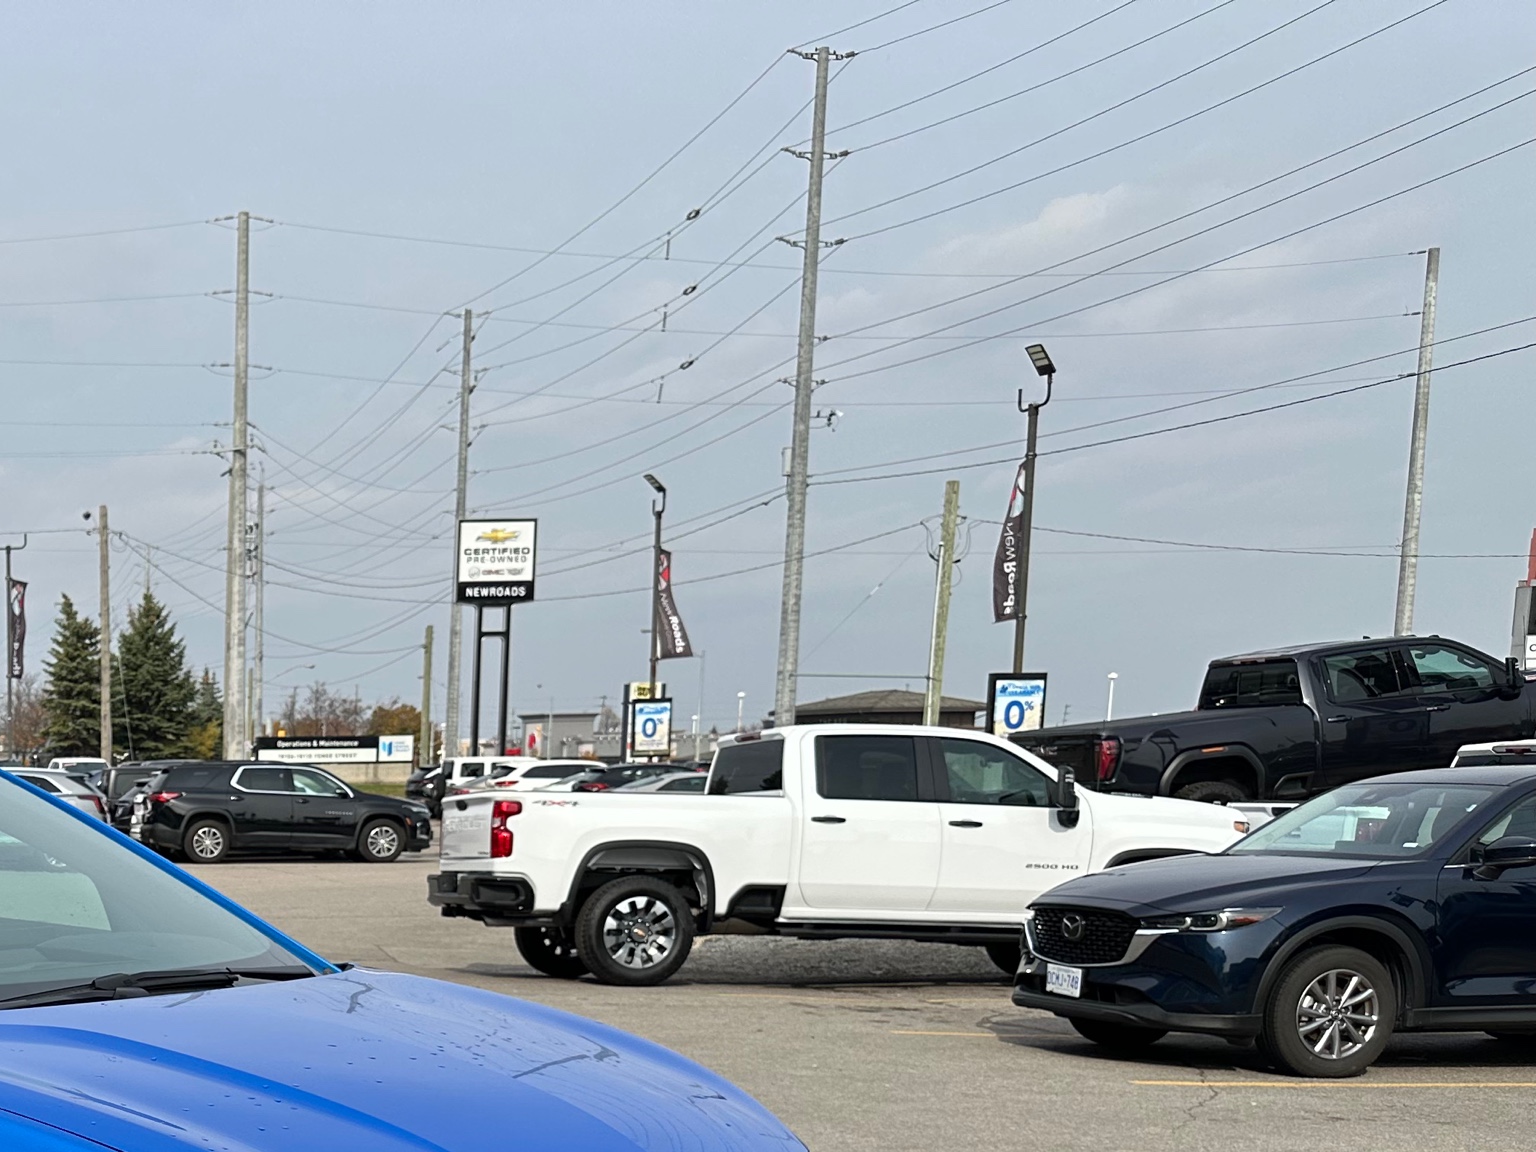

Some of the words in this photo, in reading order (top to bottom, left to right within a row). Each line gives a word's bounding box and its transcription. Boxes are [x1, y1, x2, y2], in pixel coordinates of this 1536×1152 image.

[464, 547, 531, 556] CERTIFIED
[465, 586, 526, 597] NEWROADS
[276, 740, 311, 748] Operations
